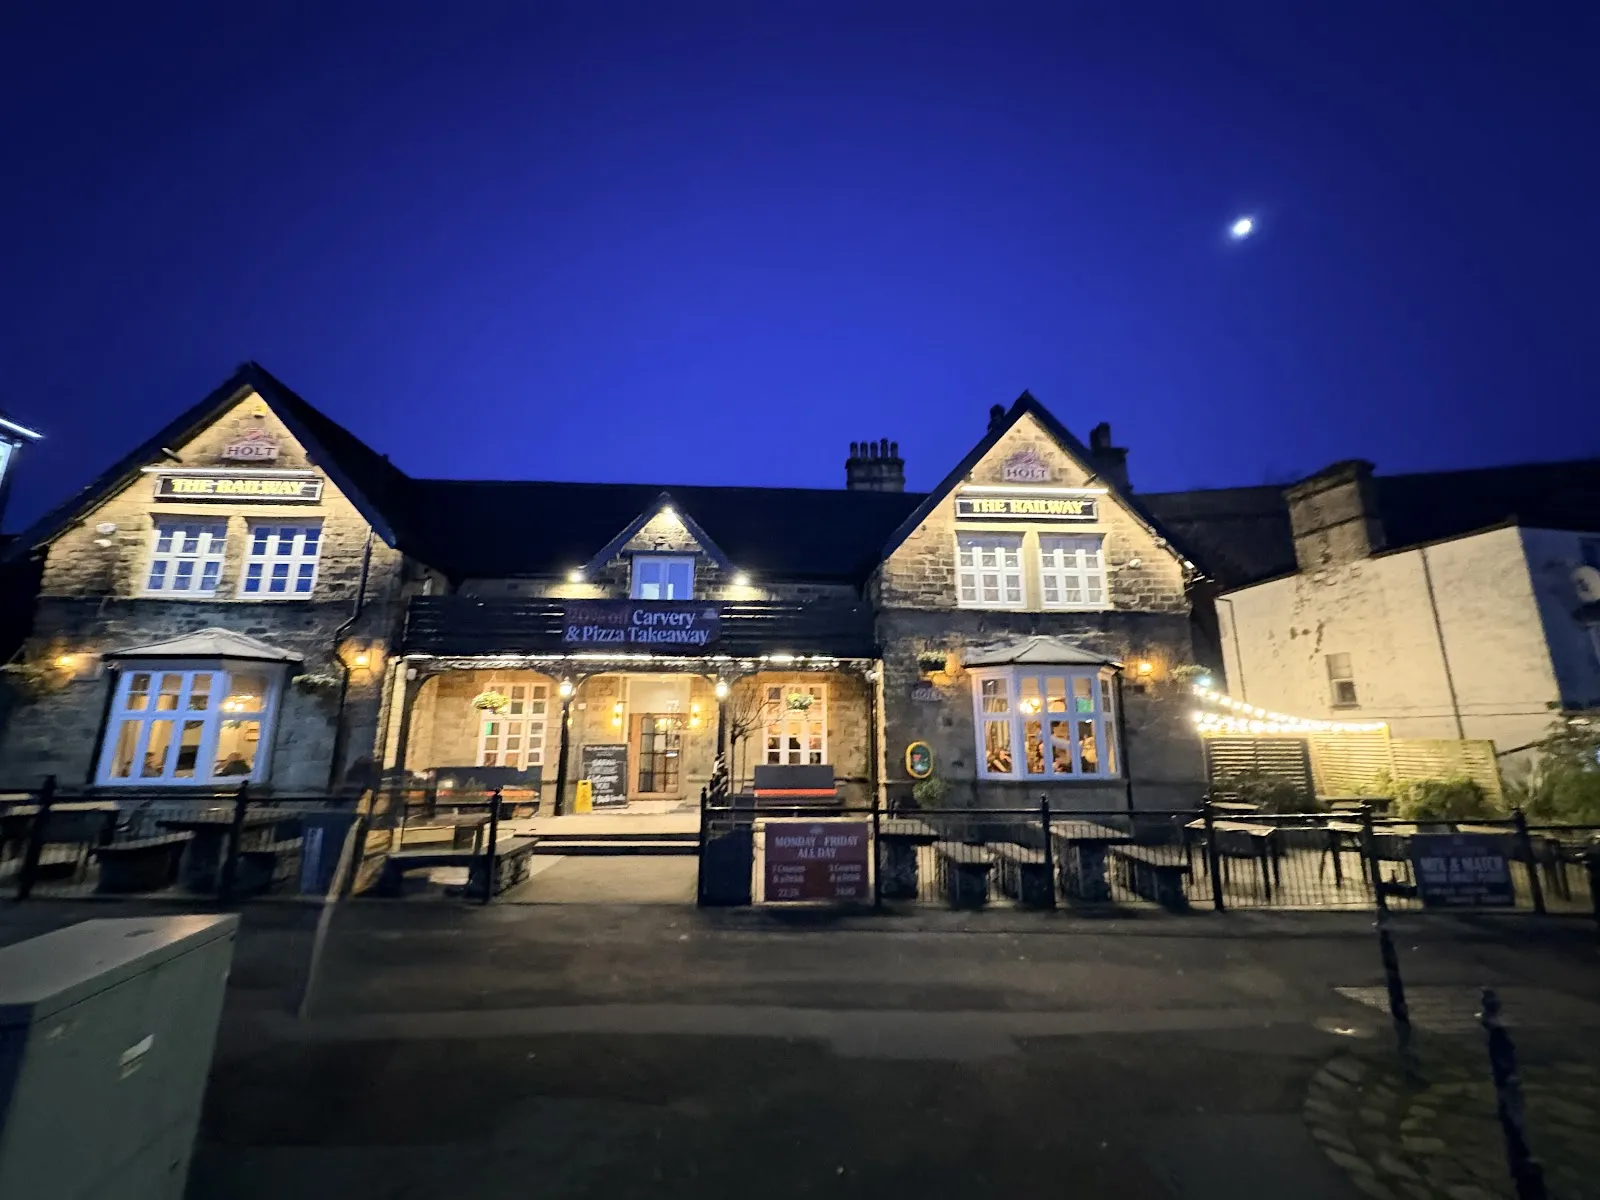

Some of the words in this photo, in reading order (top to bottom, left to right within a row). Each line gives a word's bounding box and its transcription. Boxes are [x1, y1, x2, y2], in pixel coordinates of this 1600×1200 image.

[226, 446, 274, 456] HOLT
[1006, 468, 1047, 479] HOLT
[171, 478, 214, 493] THE
[215, 479, 305, 495] RAILWAY
[972, 499, 1008, 513] THE
[1010, 500, 1083, 514] RAILWAY
[632, 609, 696, 629] Carvery
[564, 625, 580, 642] &
[582, 624, 625, 642] Pizza
[628, 626, 710, 646] Takeaway
[775, 836, 817, 848] MONDAY
[823, 836, 858, 847] FRIDAY
[797, 847, 815, 858] ALL
[817, 847, 837, 858] DAY
